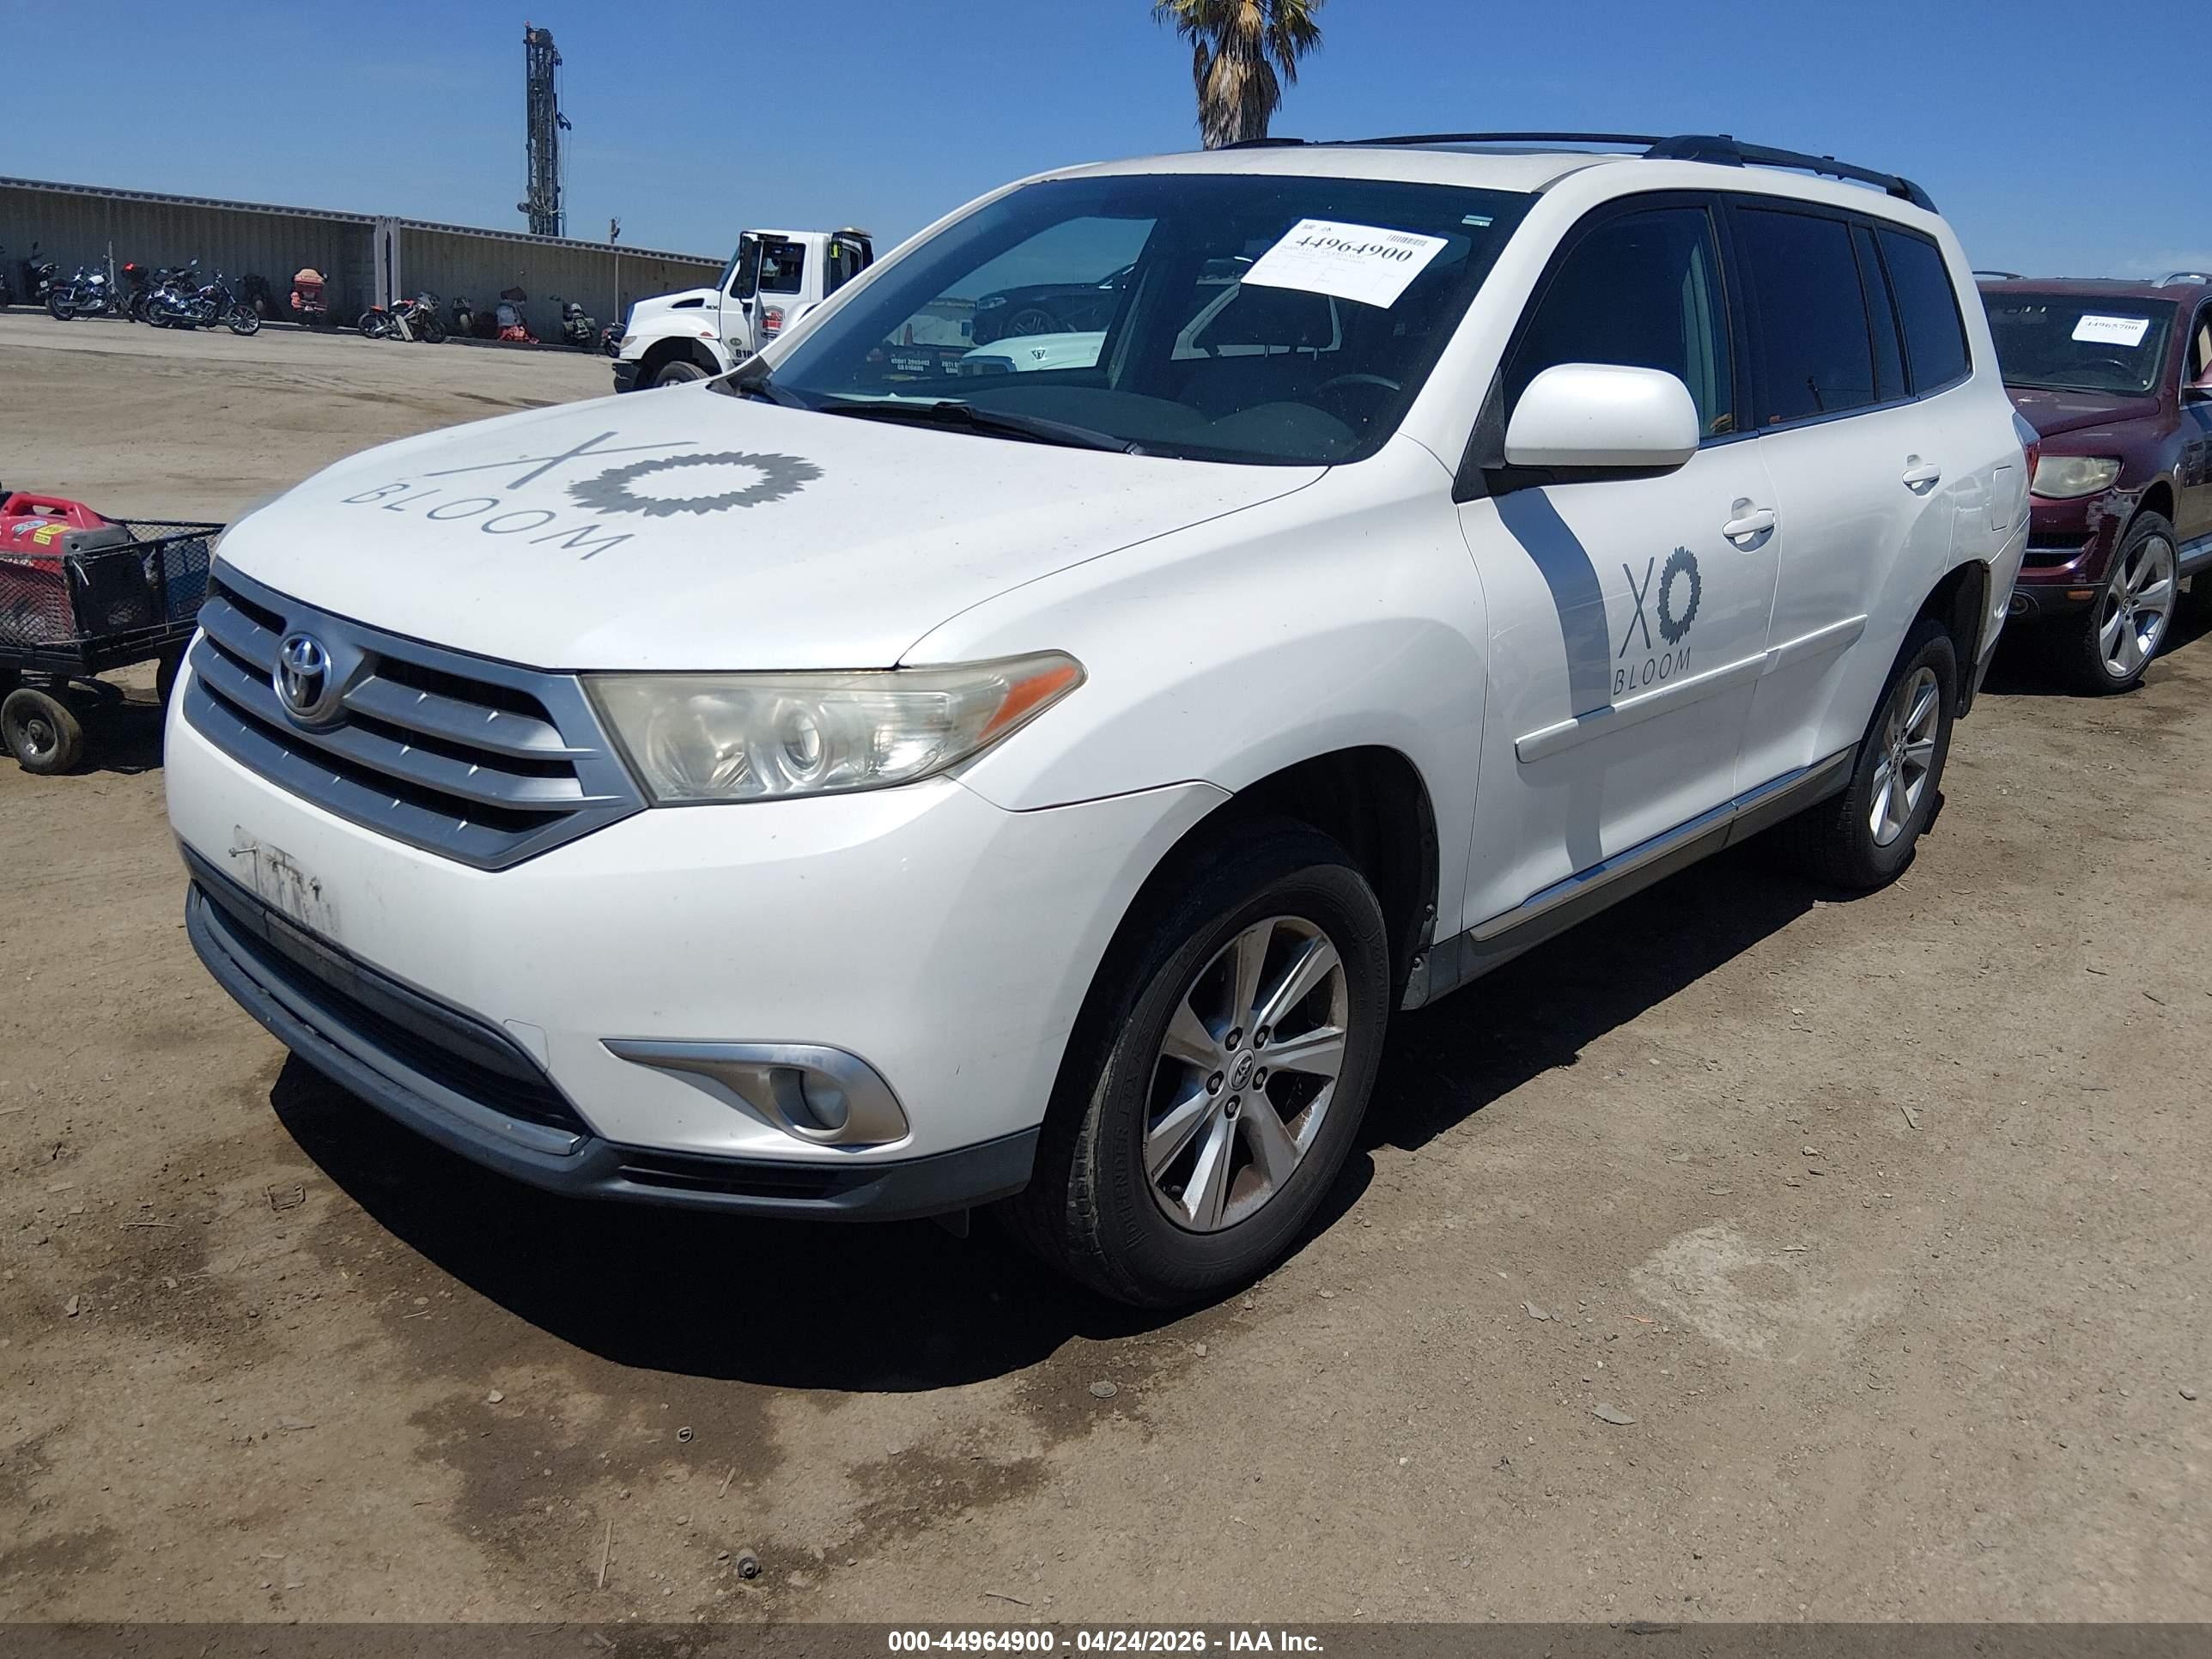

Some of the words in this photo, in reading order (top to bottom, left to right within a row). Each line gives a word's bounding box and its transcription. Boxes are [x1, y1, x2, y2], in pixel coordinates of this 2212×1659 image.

[1295, 234, 1413, 263] 44964900
[340, 483, 635, 560] BLOOM
[1613, 646, 1691, 696] BLOOM
